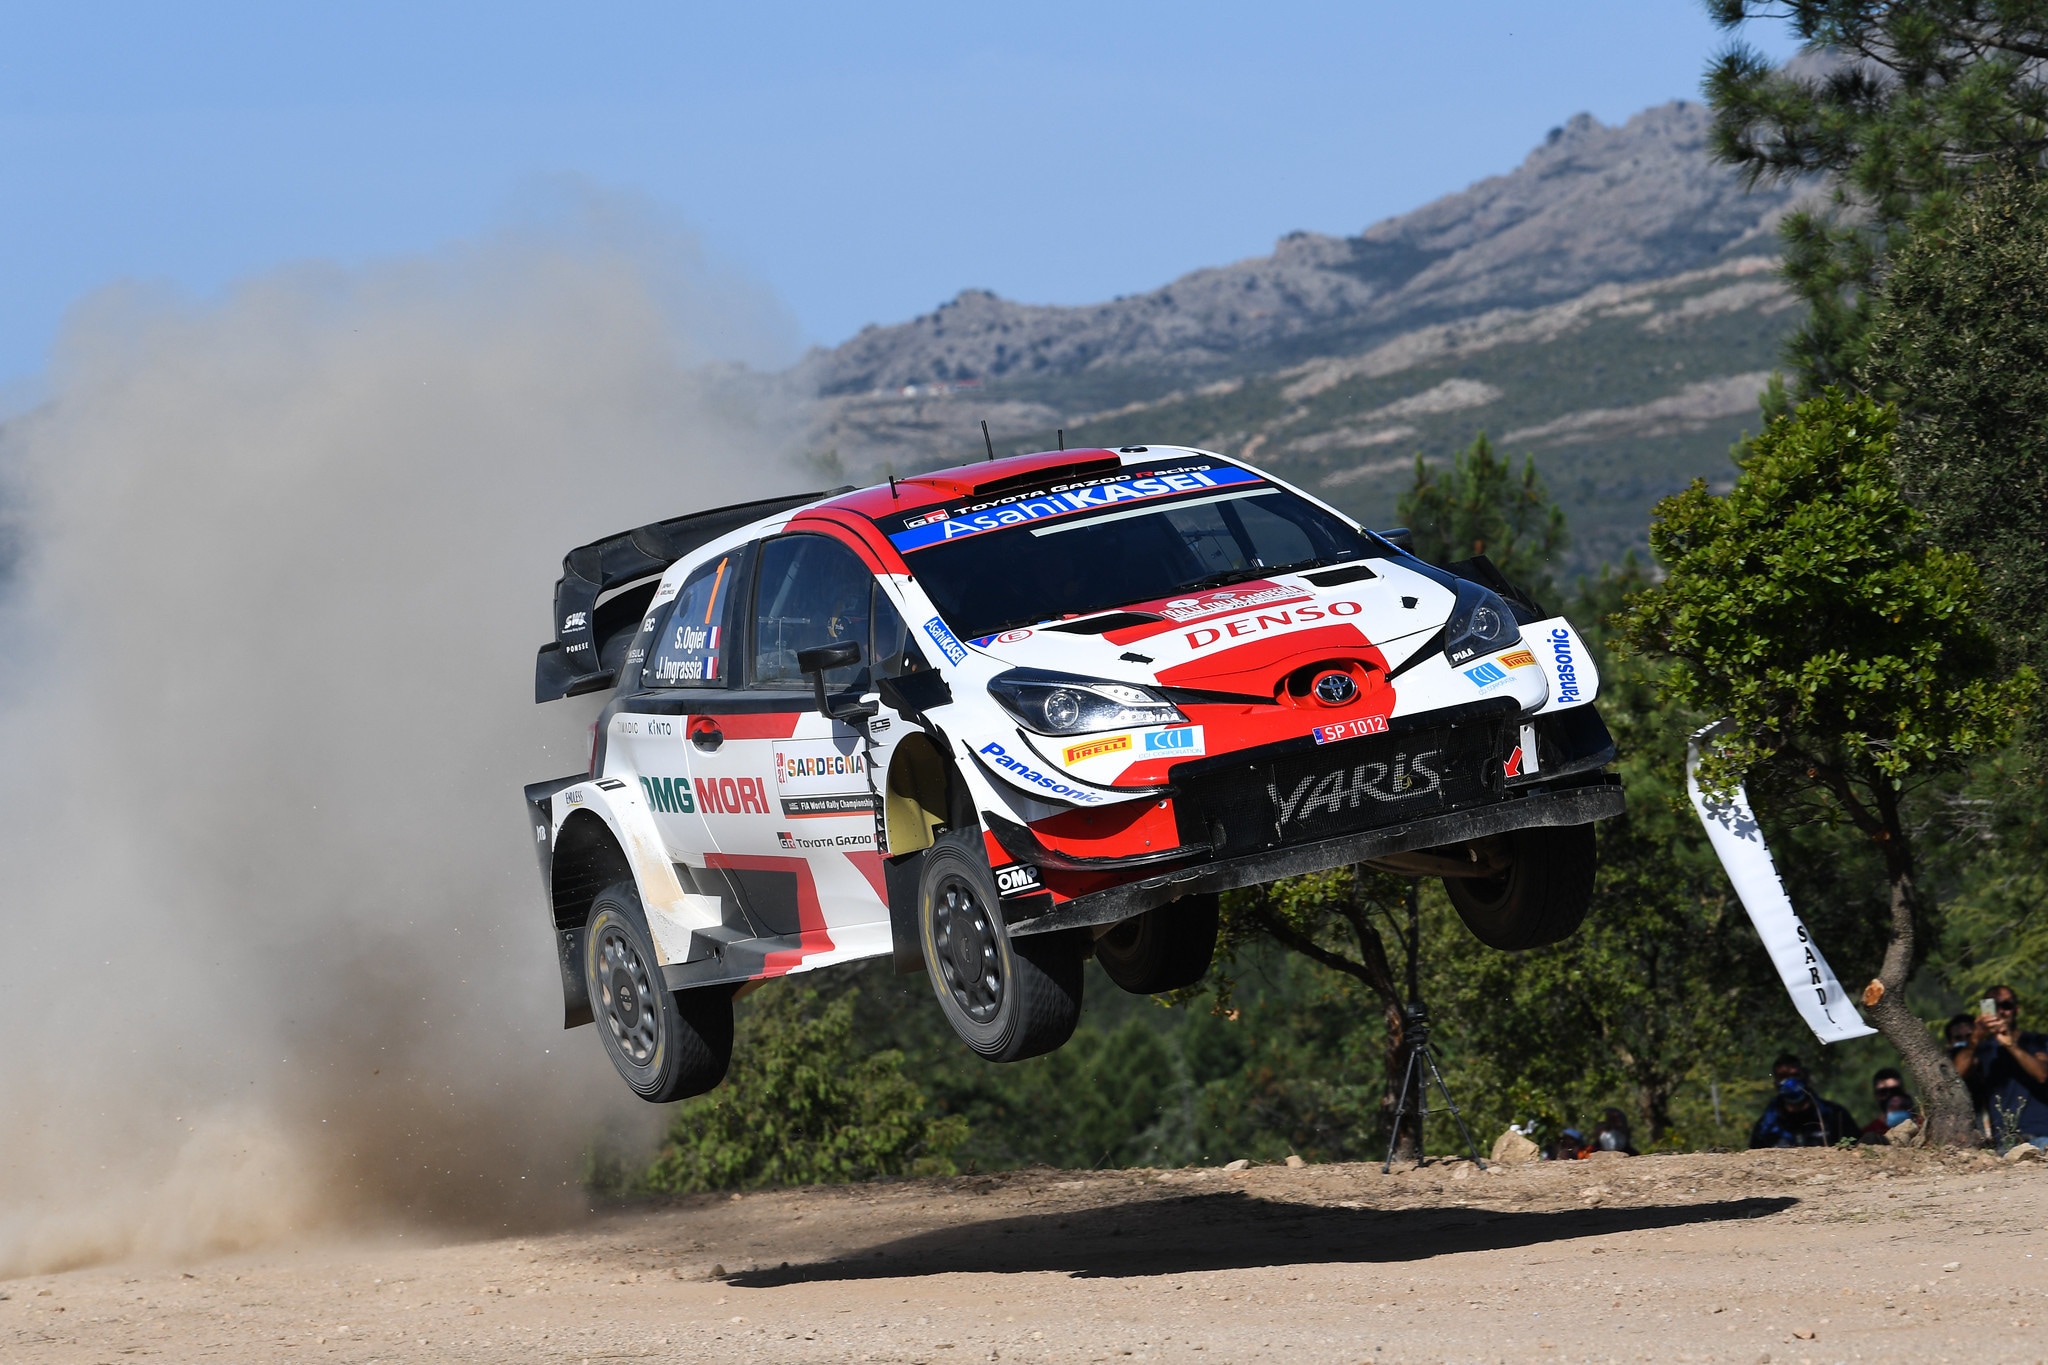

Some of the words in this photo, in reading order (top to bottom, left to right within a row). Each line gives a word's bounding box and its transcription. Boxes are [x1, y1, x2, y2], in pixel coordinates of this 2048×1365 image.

[954, 490, 1046, 515] TOYOTA
[1050, 474, 1131, 494] GAZOO
[1135, 464, 1212, 479] Racing
[944, 472, 1218, 539] AsahiKASEI
[704, 557, 729, 625] 1
[1184, 601, 1363, 650] DENSO
[566, 642, 589, 653] PONSSE
[674, 626, 707, 654] S.Ogier
[925, 619, 966, 664] AsahiKASEI
[1452, 647, 1475, 662] PIAA
[1546, 628, 1582, 704] Panasonic
[656, 656, 703, 685] J.Ingrassia
[1325, 725, 1346, 741] SP
[1349, 717, 1386, 737] 1012
[1067, 737, 1127, 763] PIRELLI
[1152, 748, 1203, 758] CORPORATION
[786, 755, 865, 778] SARDEGNA
[979, 741, 1104, 804] Panasonic
[694, 777, 771, 814] MORI
[811, 799, 826, 810] World
[825, 798, 840, 810] Rally
[796, 838, 834, 848] TOYOTA
[835, 835, 872, 846] GAZOO
[997, 866, 1039, 890] OMP
